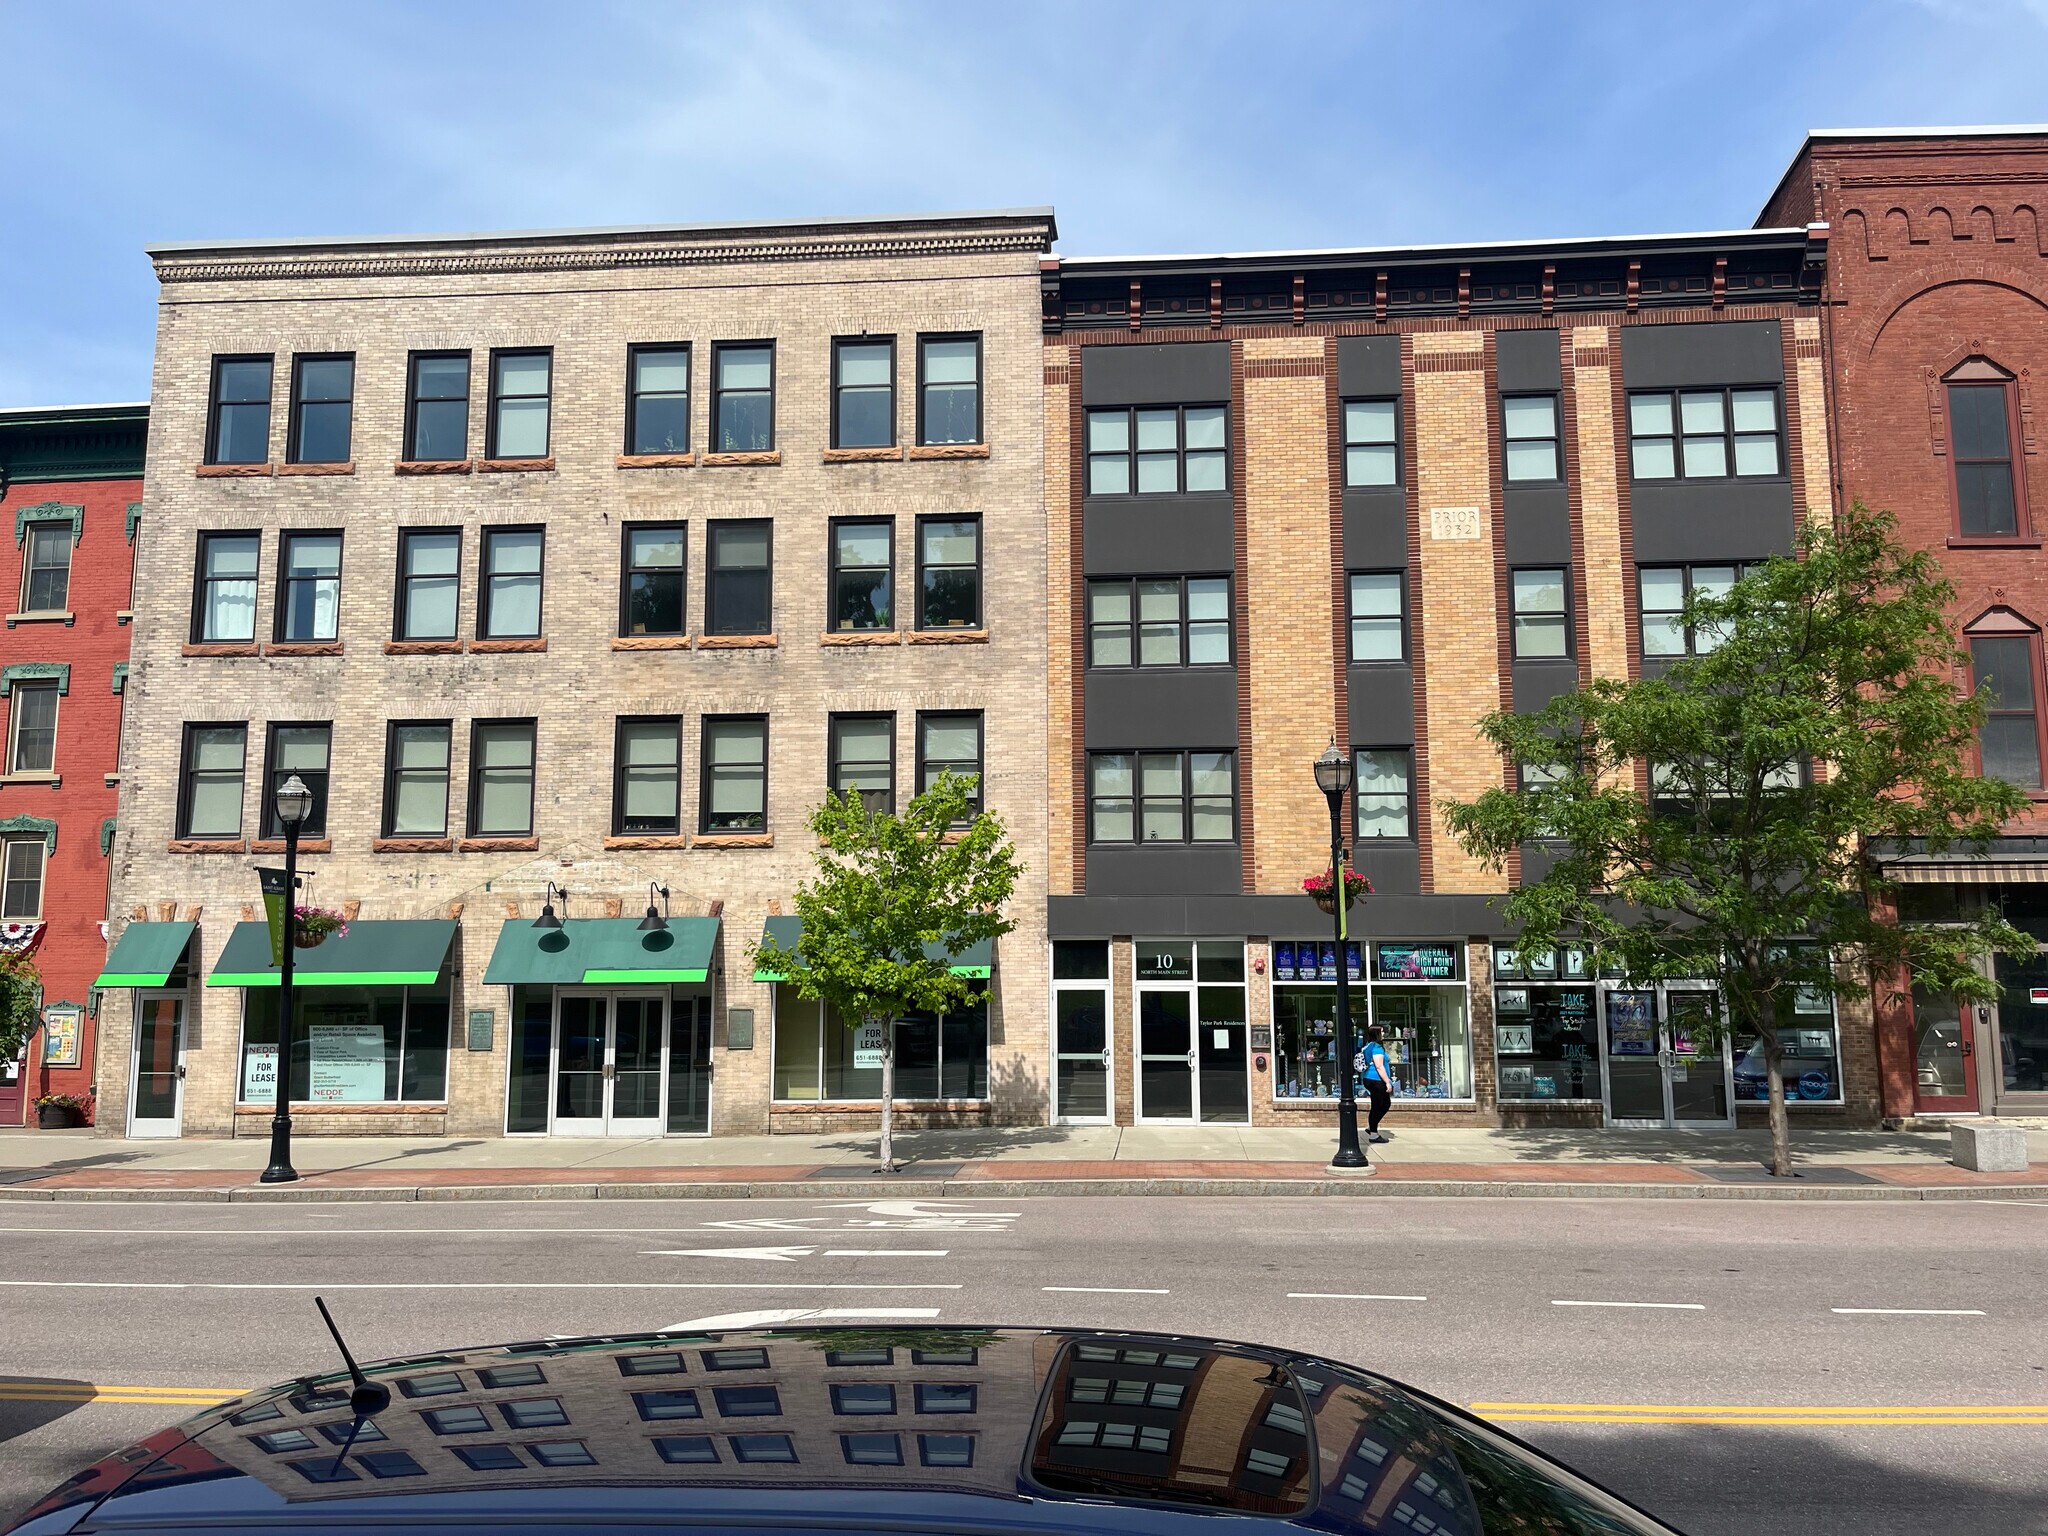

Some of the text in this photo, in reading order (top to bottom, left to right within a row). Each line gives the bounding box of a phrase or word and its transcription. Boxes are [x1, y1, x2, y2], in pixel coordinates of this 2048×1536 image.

[1434, 511, 1477, 522] PRIOR
[1439, 525, 1472, 536] 1932
[1420, 948, 1449, 957] OVERALL
[1156, 954, 1173, 968] 10
[1415, 957, 1432, 966] HIGH
[1433, 957, 1453, 966] POINT
[1421, 967, 1449, 976] WINNER
[1560, 993, 1585, 1005] TAKE
[865, 1029, 881, 1037] FOR
[860, 1040, 881, 1049] LEAS
[1562, 1044, 1587, 1056] TAKE
[257, 1063, 272, 1071] FOR
[251, 1074, 276, 1082] LEASE
[1800, 1081, 1828, 1089] GROOVE
